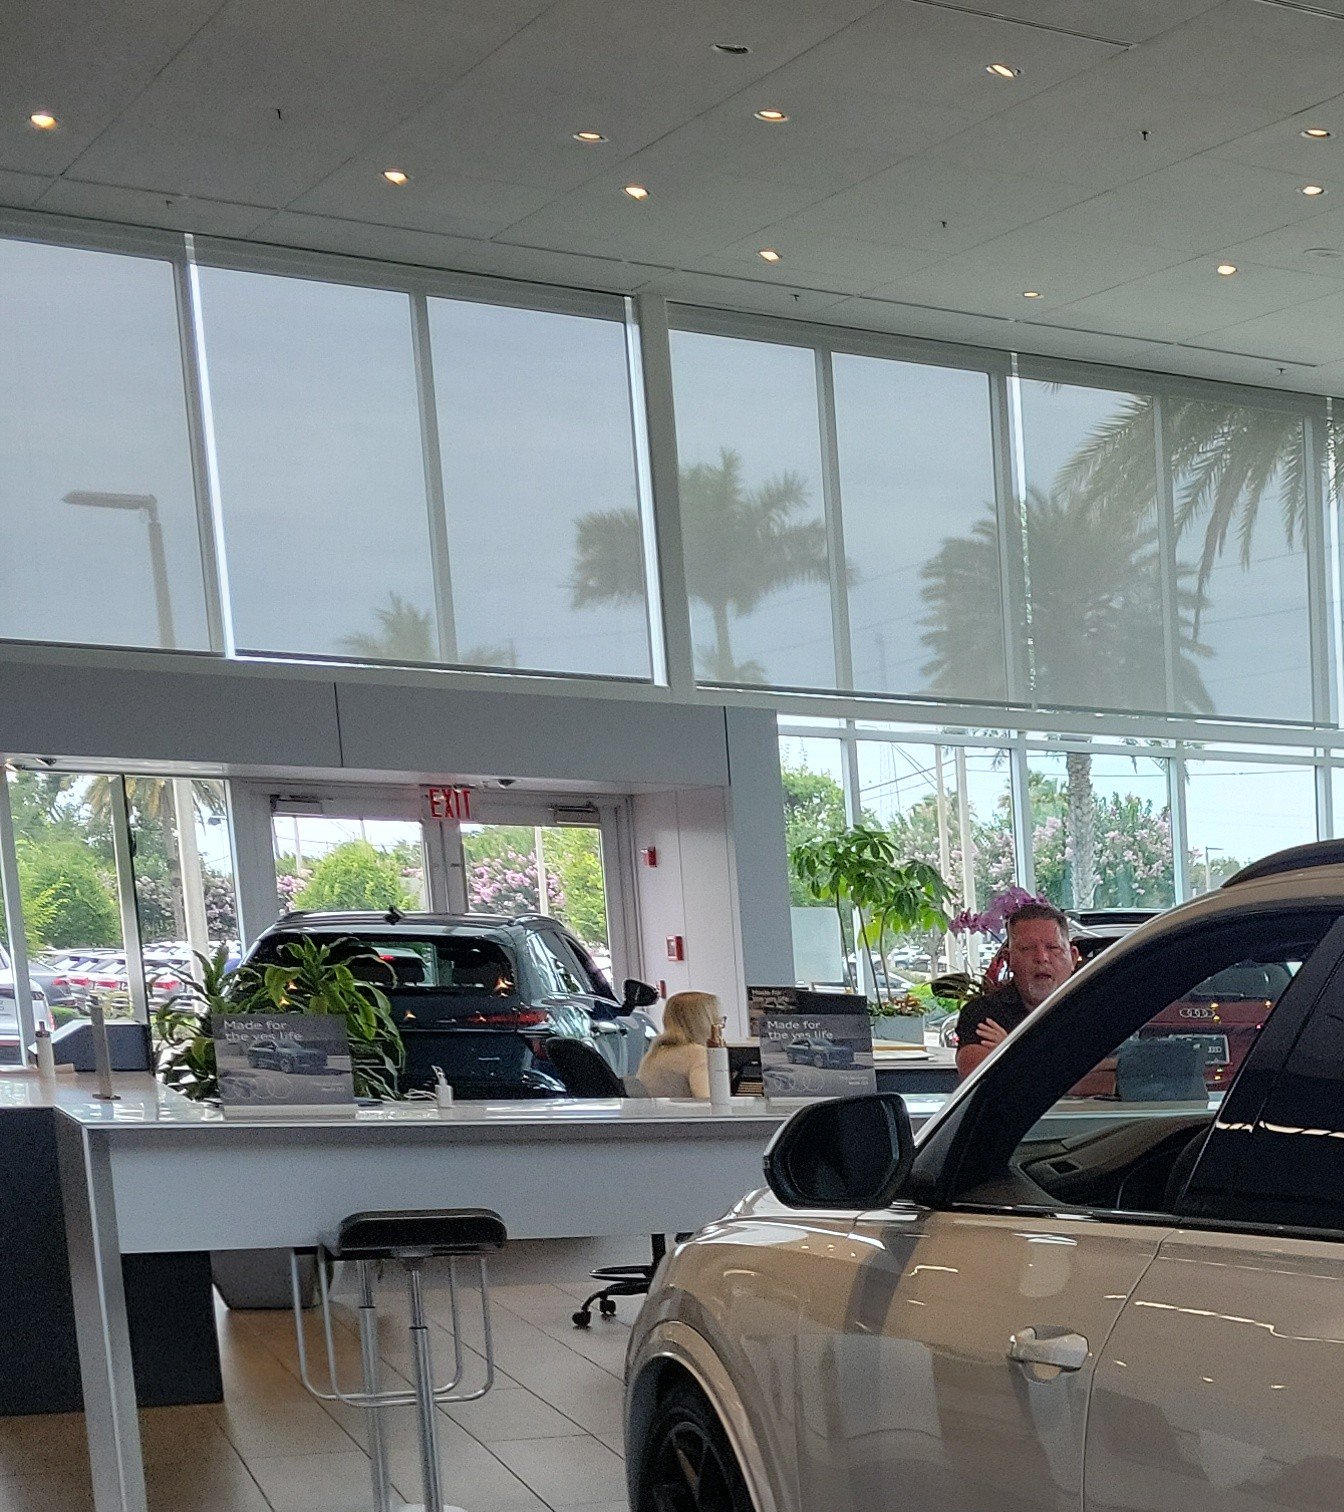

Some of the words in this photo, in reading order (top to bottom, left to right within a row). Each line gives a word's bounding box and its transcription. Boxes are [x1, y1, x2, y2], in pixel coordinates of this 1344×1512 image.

[429, 789, 470, 819] EXIT
[224, 1020, 263, 1030] Made
[266, 1020, 288, 1030] for
[767, 1020, 800, 1030] Made
[803, 1020, 821, 1030] for
[225, 1032, 250, 1042] the
[280, 1031, 304, 1042] life
[768, 1032, 789, 1041] the
[814, 1030, 834, 1041] life
